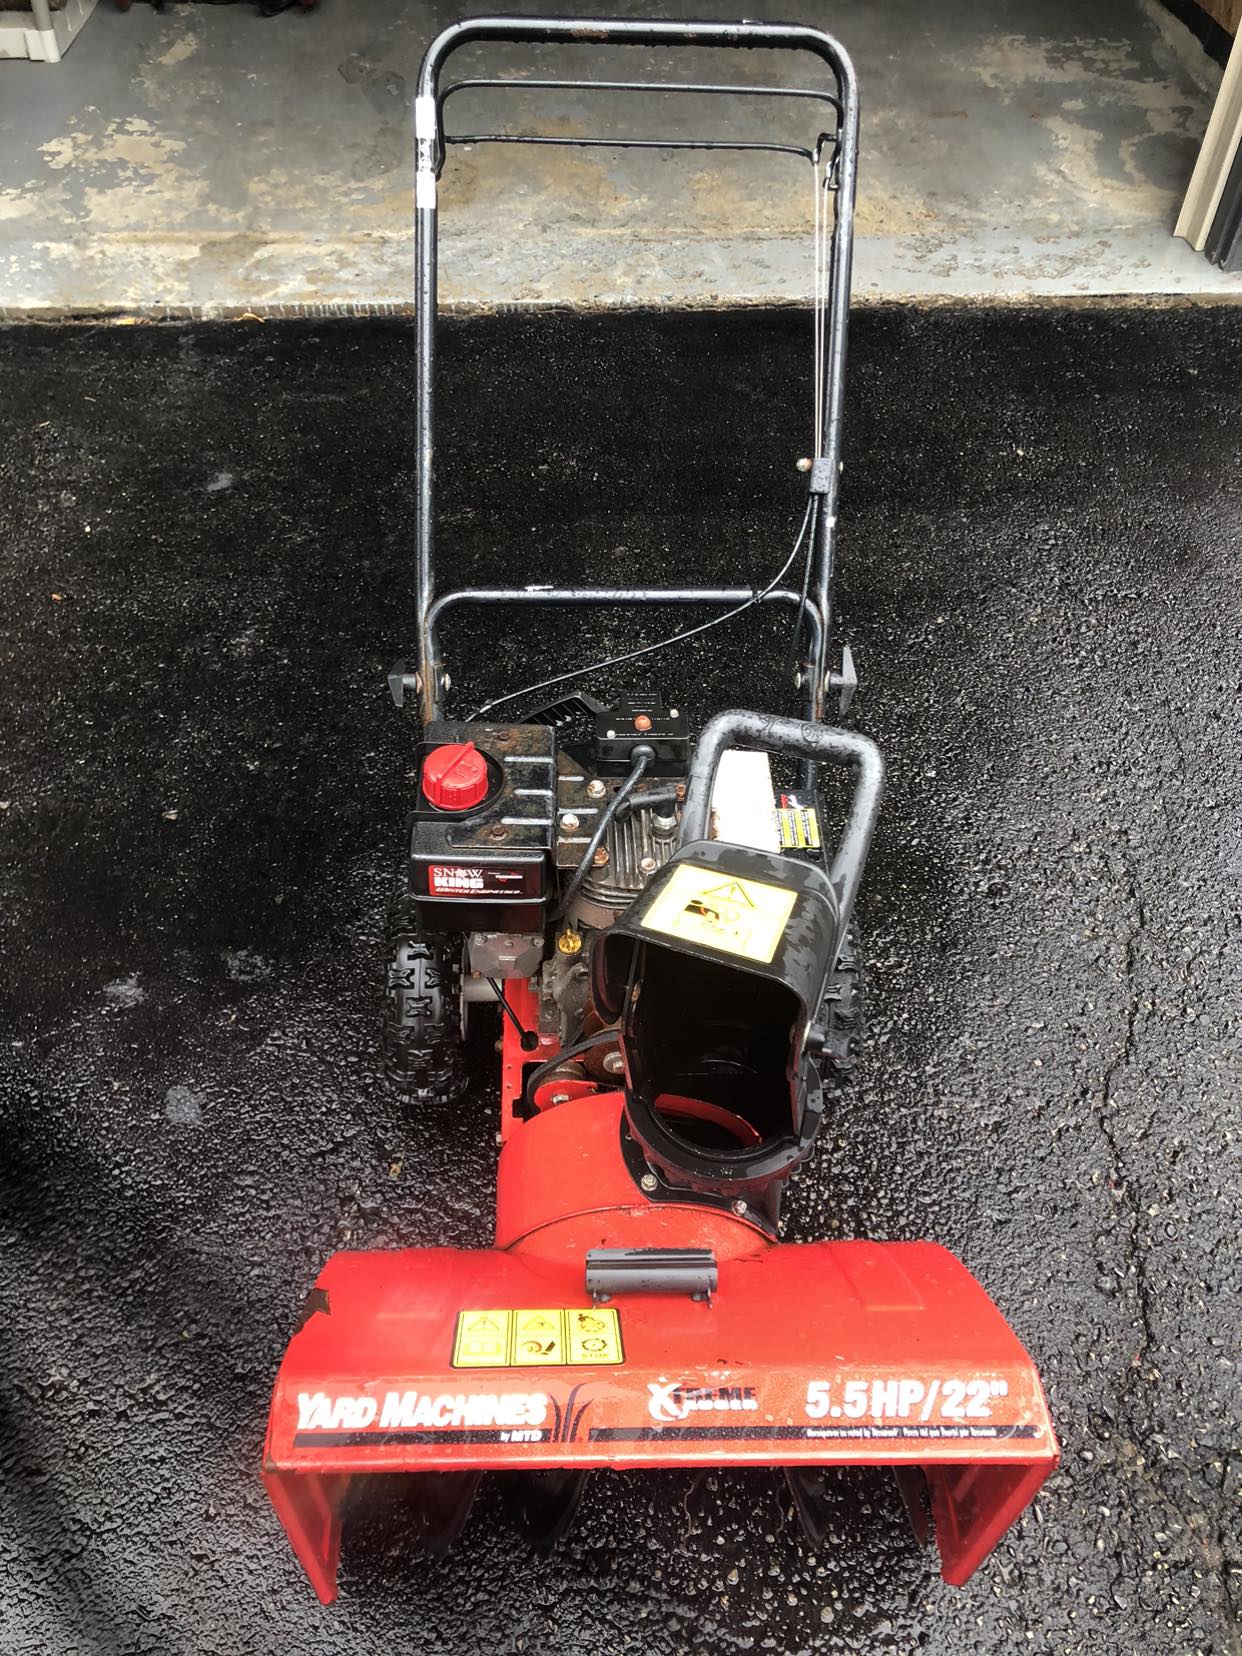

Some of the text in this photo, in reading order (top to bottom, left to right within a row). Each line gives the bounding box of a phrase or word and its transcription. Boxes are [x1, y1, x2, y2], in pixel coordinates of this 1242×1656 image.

[434, 877, 484, 888] KING
[297, 1391, 548, 1430] YARD MACHINES
[804, 1380, 1009, 1421] 5.5HP/22"
[511, 1430, 543, 1442] MTD
